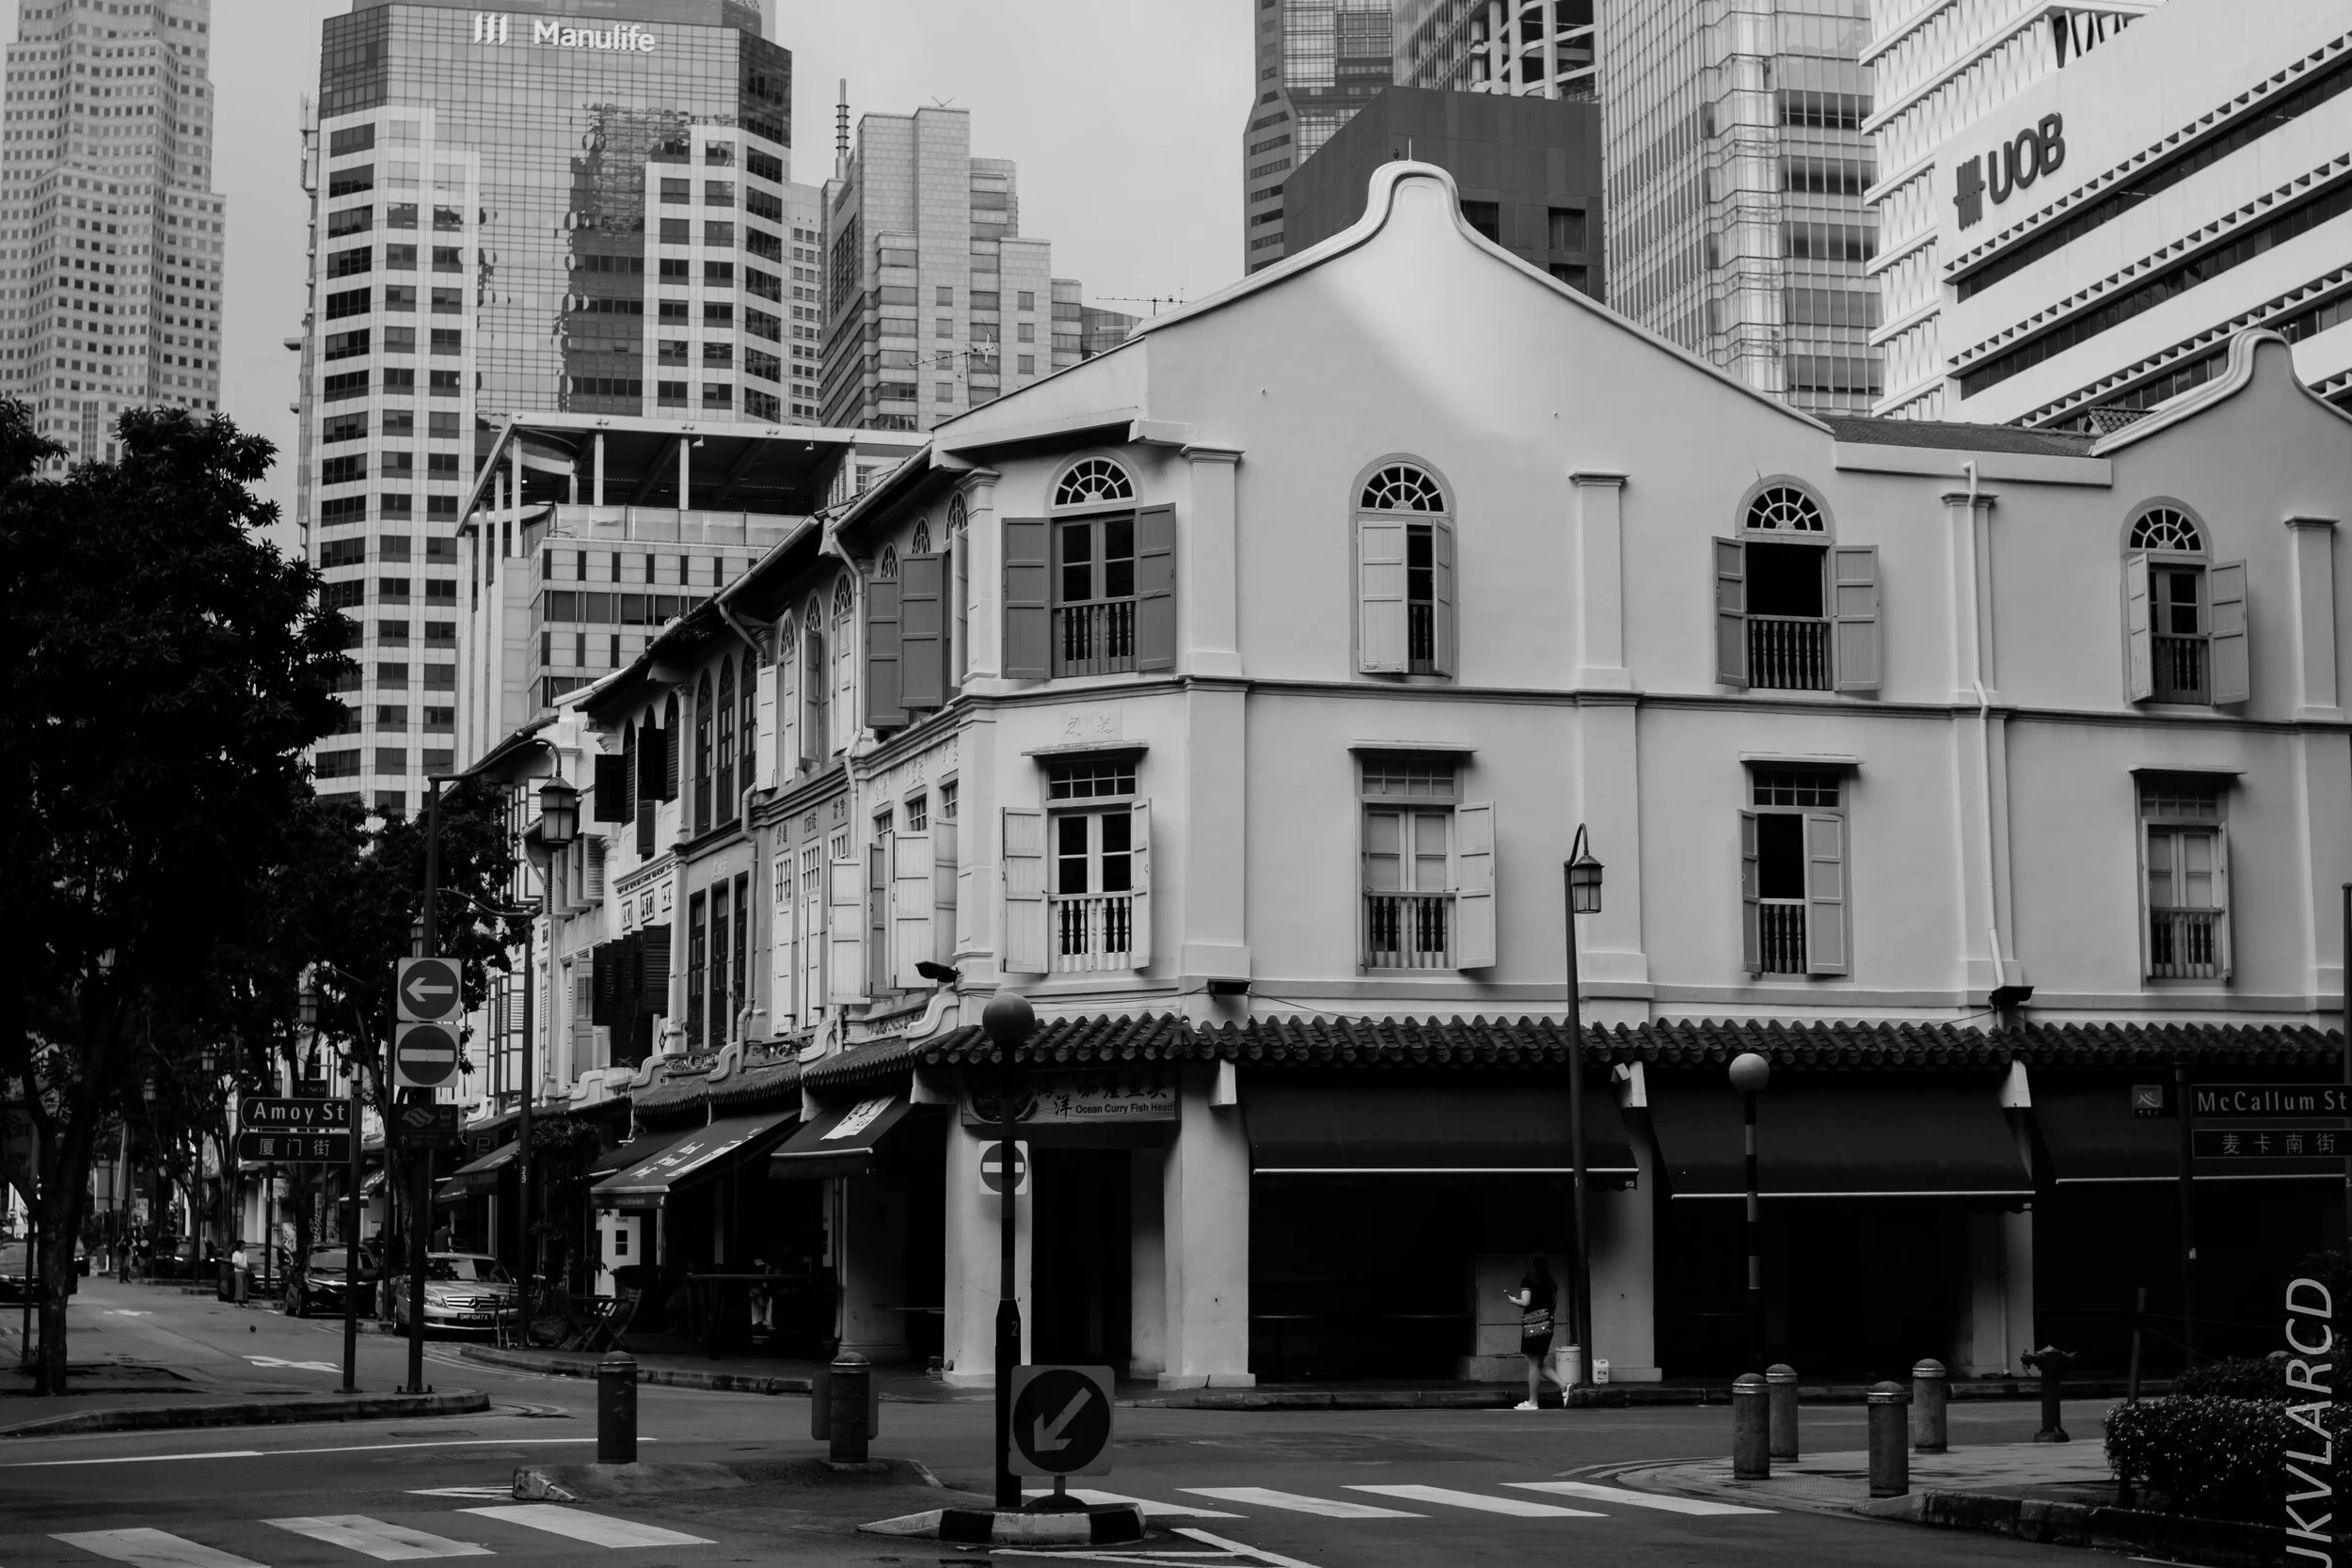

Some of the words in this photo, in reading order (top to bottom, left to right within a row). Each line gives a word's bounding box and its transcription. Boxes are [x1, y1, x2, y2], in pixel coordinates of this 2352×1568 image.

[533, 21, 656, 52] Manulife
[1988, 112, 2066, 204] UOB
[1075, 1104, 1103, 1114] Ocean
[1104, 1103, 1128, 1116] Curry
[1130, 1102, 1149, 1113] Fish
[1151, 1101, 1173, 1112] Head
[2198, 1090, 2314, 1112] McCallum
[2324, 1089, 2347, 1111] St
[253, 1101, 314, 1123] Amoy
[323, 1101, 344, 1121] St
[259, 1138, 330, 1157] 厦门街
[2221, 1132, 2335, 1155] 麦卡南街
[1010, 1320, 1020, 1338] 2
